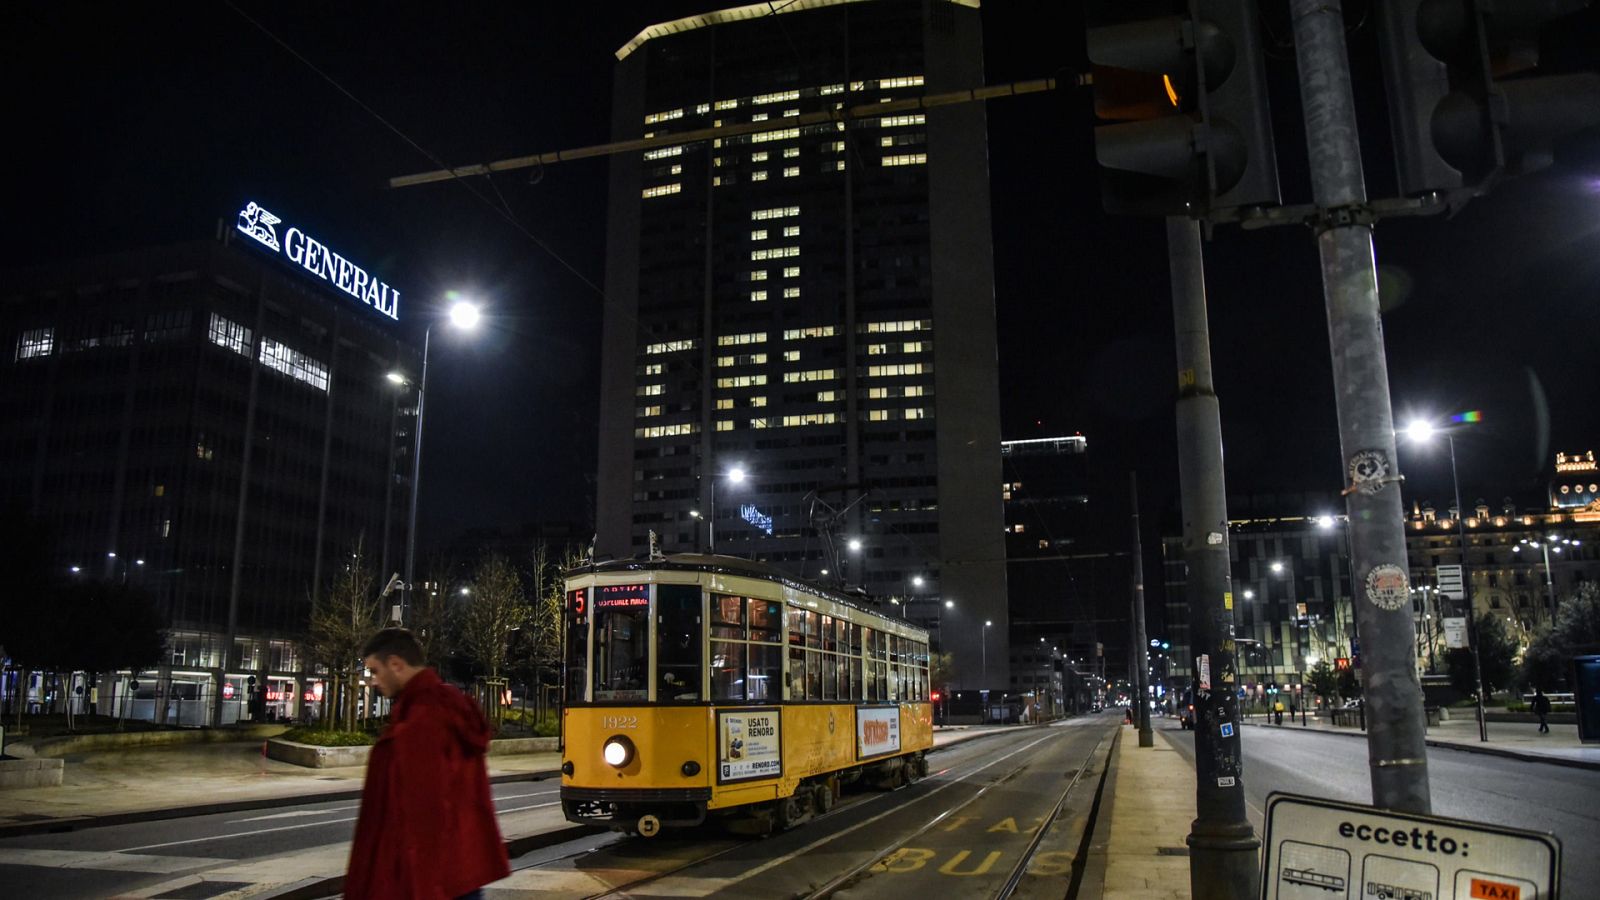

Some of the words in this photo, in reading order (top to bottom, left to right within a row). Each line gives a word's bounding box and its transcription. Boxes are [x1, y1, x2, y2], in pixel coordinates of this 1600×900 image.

[285, 227, 400, 320] GENERALI
[575, 590, 584, 613] 5
[603, 716, 638, 729] 1922
[747, 717, 769, 728] USATO
[748, 727, 774, 737] RENORD
[1338, 820, 1470, 857] eccetto:
[868, 847, 1076, 876] BUS
[1480, 884, 1516, 900] TAXI
